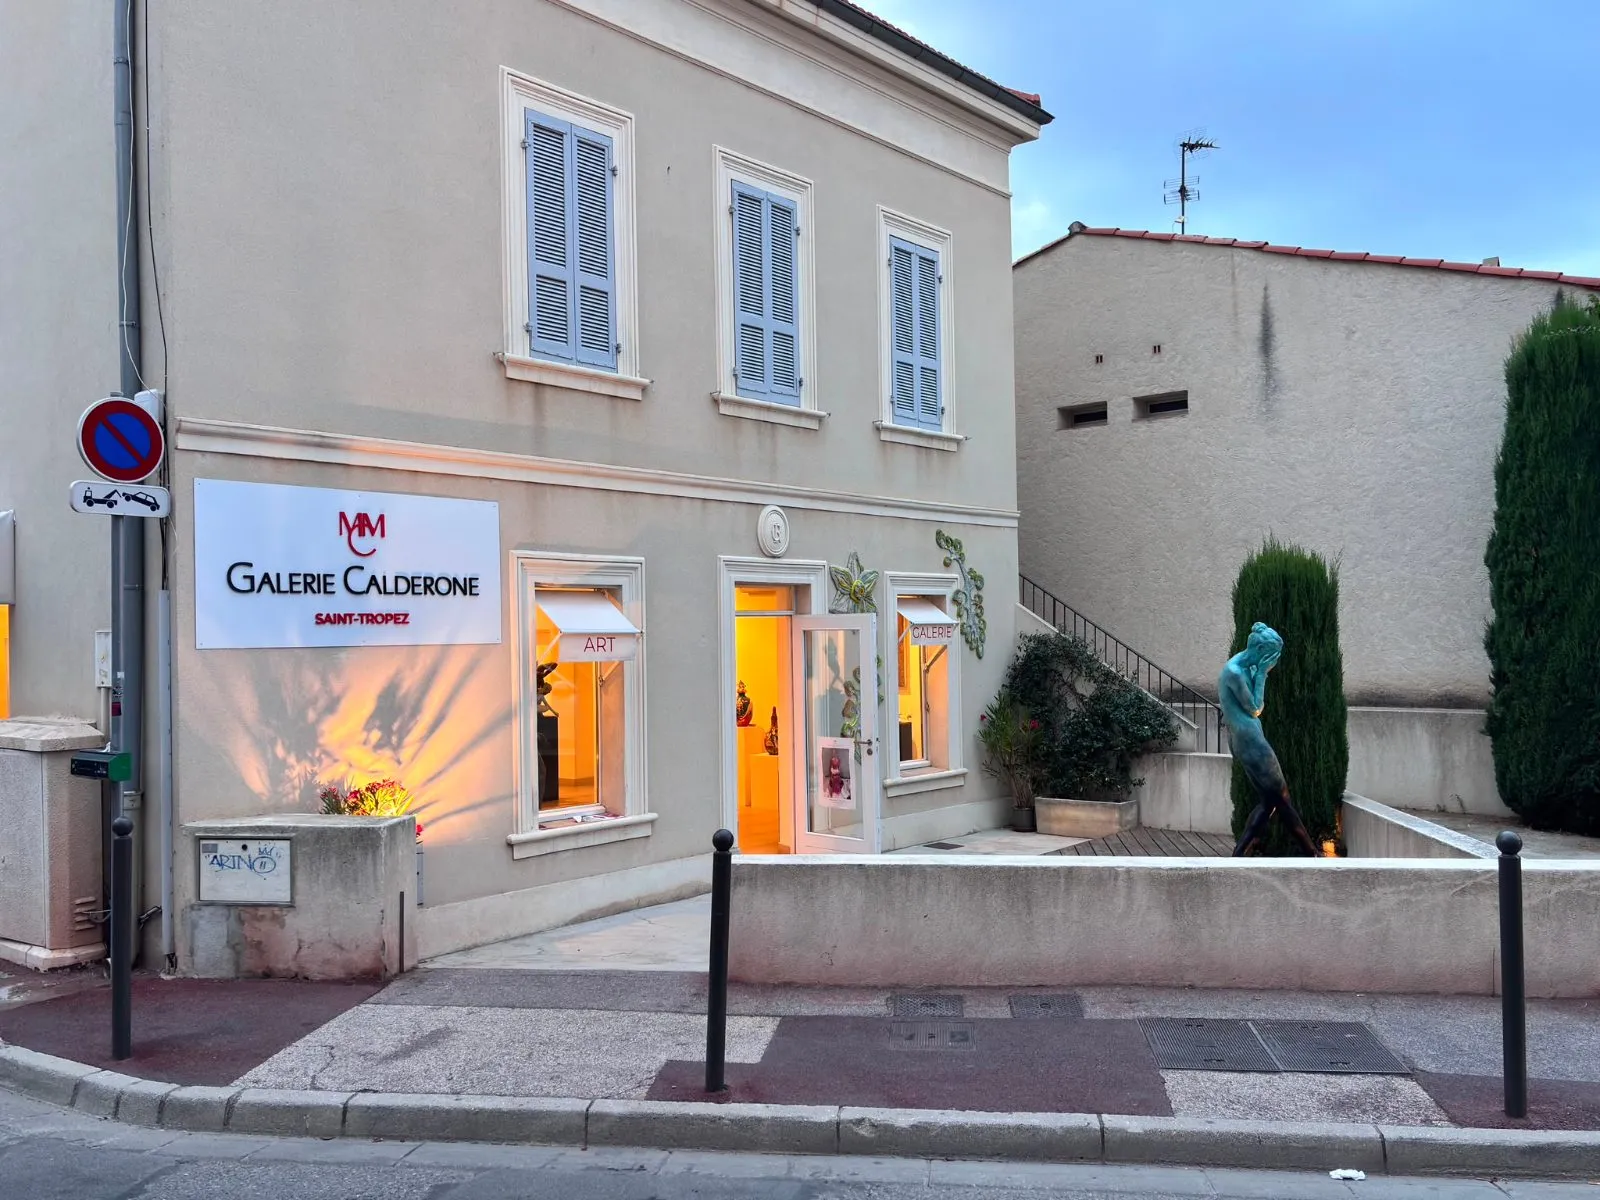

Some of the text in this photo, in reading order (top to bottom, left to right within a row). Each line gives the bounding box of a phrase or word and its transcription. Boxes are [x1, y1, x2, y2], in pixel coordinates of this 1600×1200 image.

[226, 561, 480, 596] GALERIE CALDERONE
[314, 612, 410, 626] SAINT-TROPEZ
[912, 626, 952, 639] GALERIE
[583, 636, 616, 653] ART
